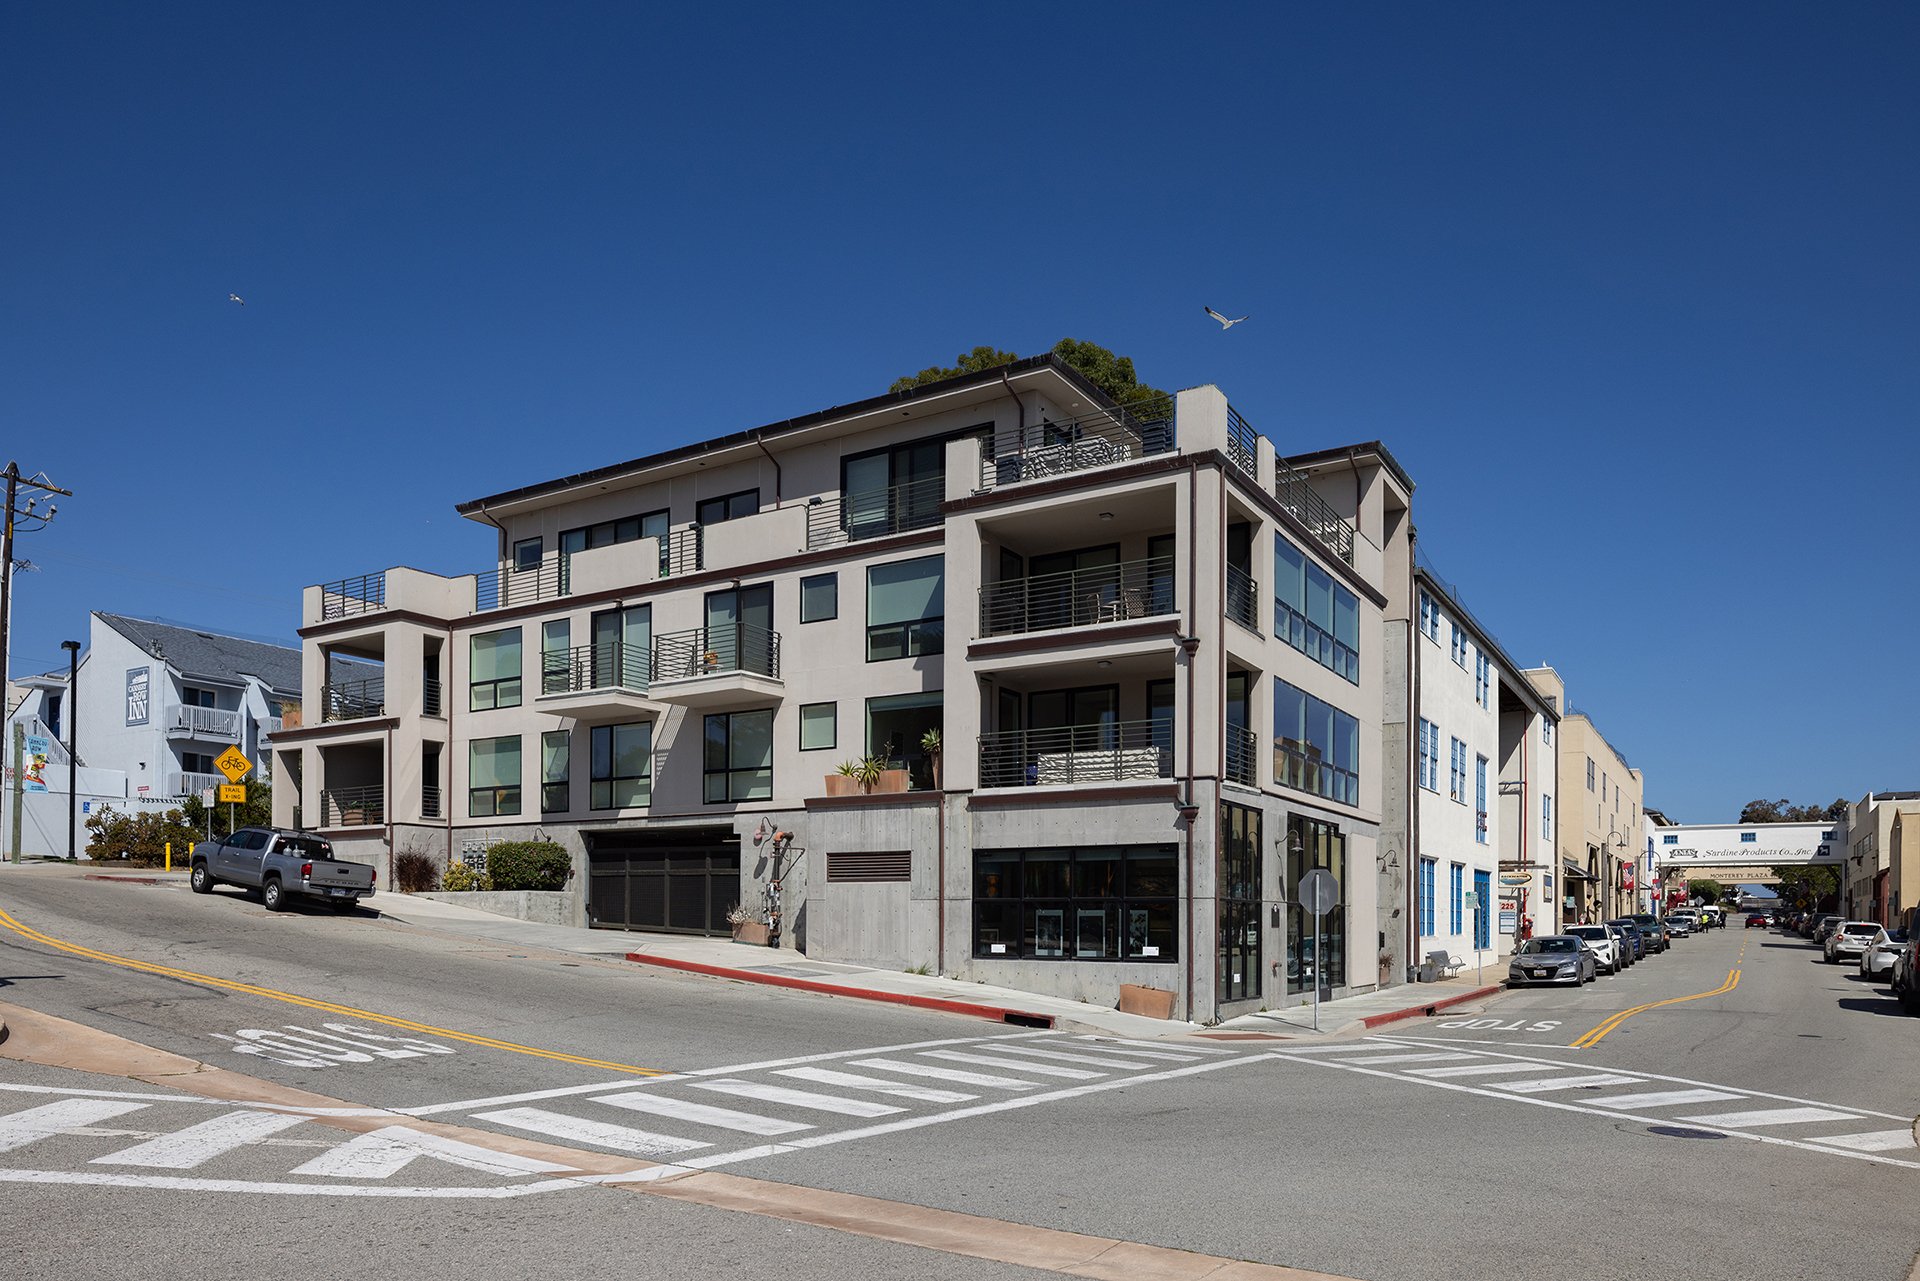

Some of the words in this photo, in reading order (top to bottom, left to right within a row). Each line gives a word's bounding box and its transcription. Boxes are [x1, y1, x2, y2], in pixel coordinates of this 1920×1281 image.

[133, 691, 147, 701] ROW
[128, 697, 148, 720] INN
[1703, 849, 1738, 858] Sardine
[1739, 848, 1777, 856] Products
[1436, 1019, 1562, 1032] STOP
